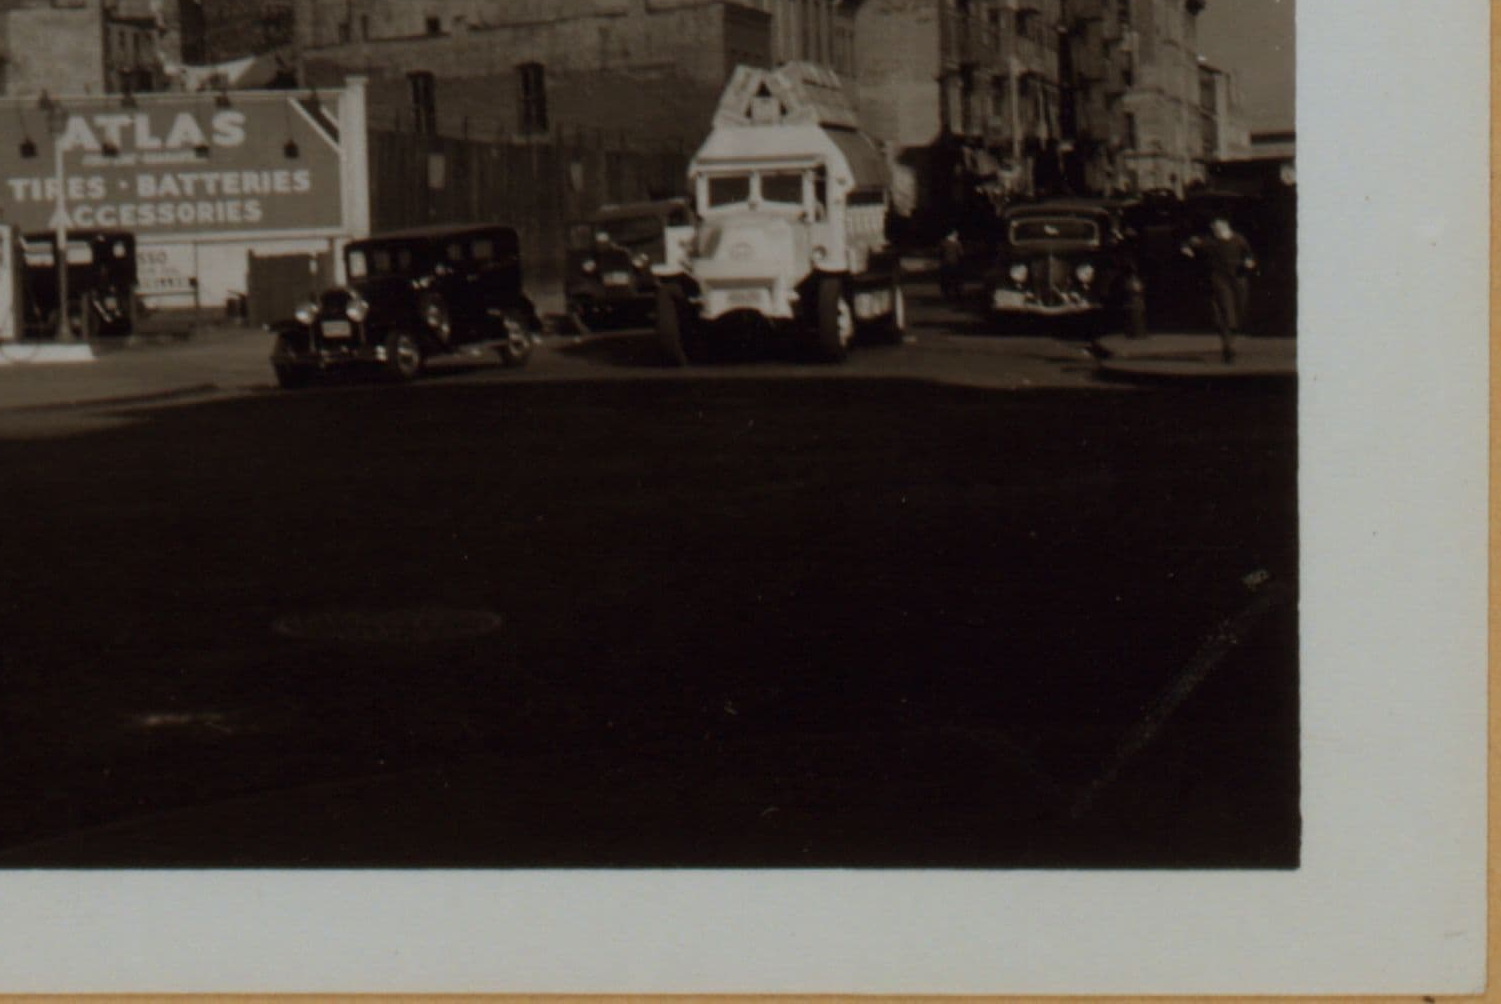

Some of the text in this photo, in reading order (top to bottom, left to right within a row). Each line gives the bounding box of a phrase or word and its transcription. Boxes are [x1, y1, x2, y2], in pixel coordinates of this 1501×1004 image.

[57, 111, 246, 152] ATLAS
[7, 169, 313, 202] TIRES BATTERIES
[48, 199, 263, 229] ACCESSORIES
